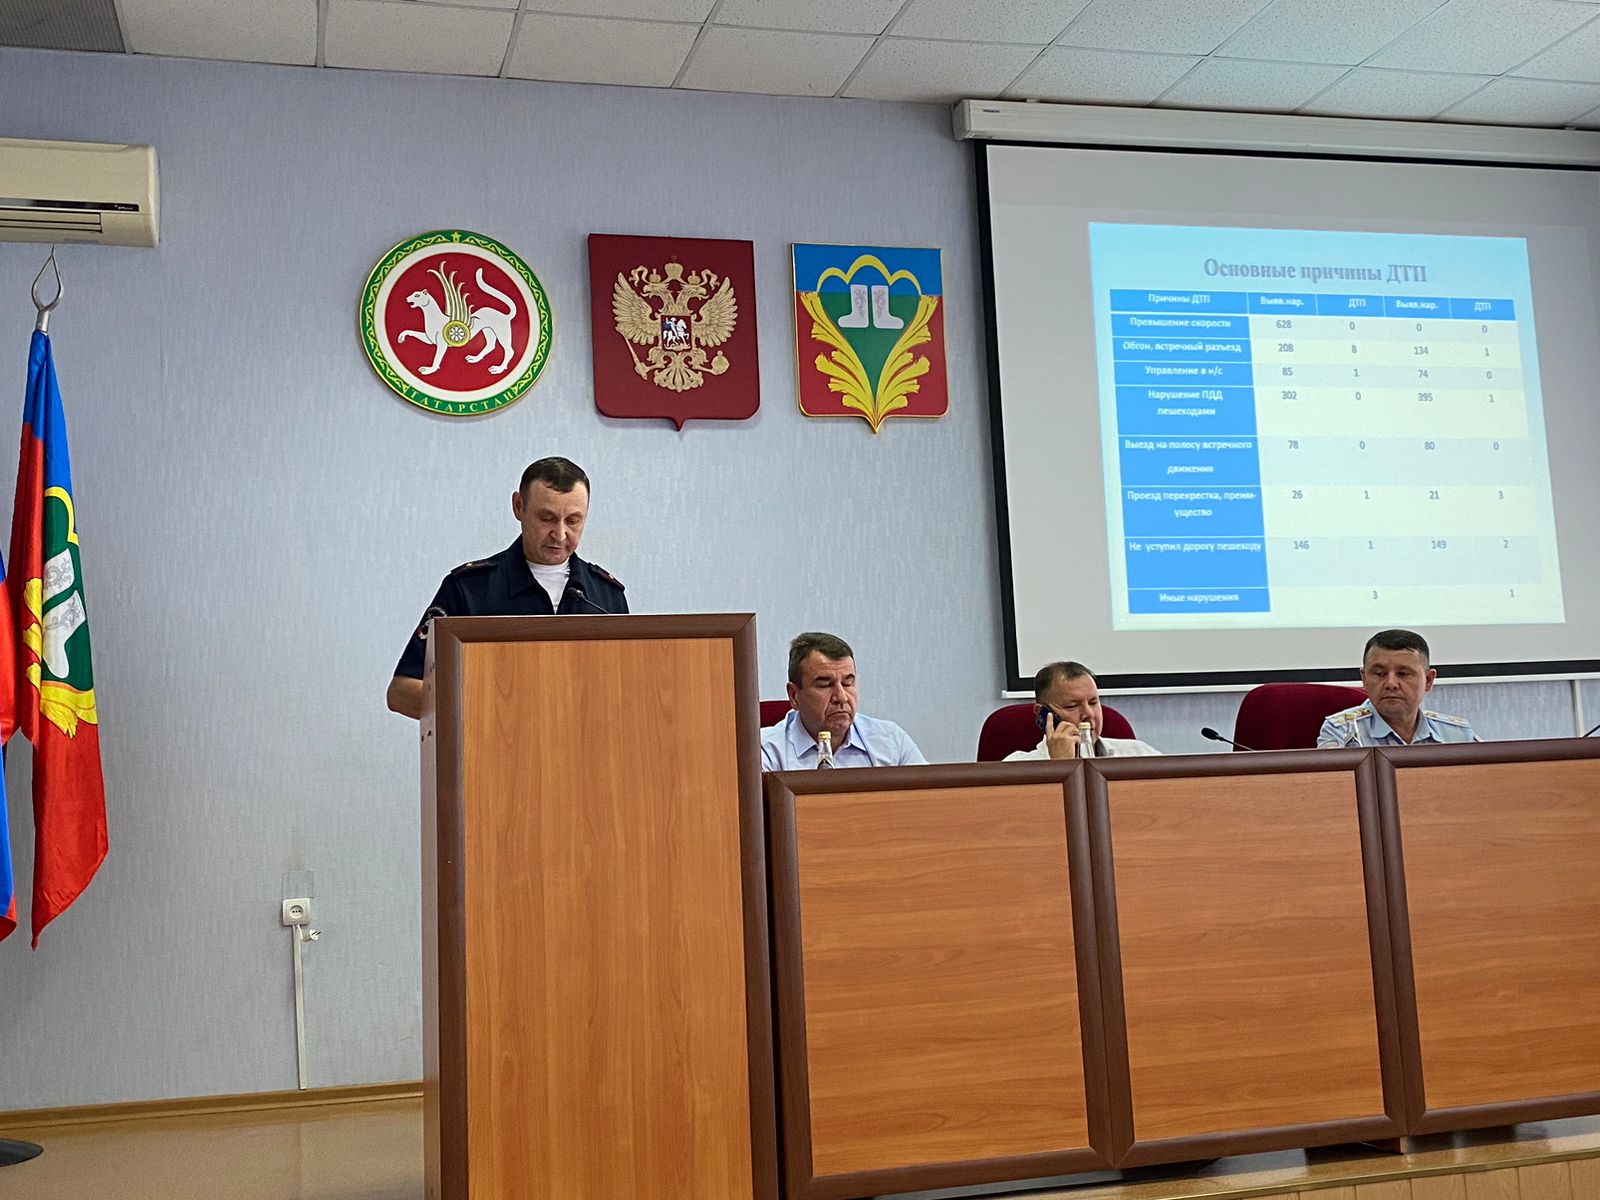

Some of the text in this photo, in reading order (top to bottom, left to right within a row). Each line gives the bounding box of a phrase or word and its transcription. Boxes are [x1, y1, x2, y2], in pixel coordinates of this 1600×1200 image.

[1204, 258, 1427, 284] Основные причины ДТП
[1148, 293, 1210, 304] Причины ДТП
[1260, 296, 1304, 306] Выяв.нар.
[1348, 299, 1366, 308] ДТП
[1396, 300, 1438, 310] Выяв.нар.
[1474, 302, 1491, 311] ДТП
[1130, 318, 1231, 328] Превышение скорости
[1276, 320, 1292, 329] 628
[1350, 322, 1355, 330] 0
[1417, 324, 1422, 332] 0
[1482, 325, 1488, 333] 0
[1155, 342, 1203, 352] встречный
[1205, 344, 1241, 353] разъезд
[1278, 344, 1293, 352] 208
[1352, 345, 1357, 354] 8
[1414, 346, 1429, 355] 134
[1145, 366, 1199, 375] Управление
[1208, 366, 1223, 375] н/с
[1282, 368, 1293, 376] 85
[1418, 370, 1428, 378] 74
[1487, 371, 1492, 379] 0
[1148, 391, 1223, 400] Нарушение ПДД
[1282, 391, 1297, 400] 302
[1356, 392, 1361, 400] 0
[1418, 393, 1433, 402] 395
[409, 390, 514, 413] ТАТАРСТАН
[1158, 408, 1216, 416] пешеходами
[1125, 440, 1154, 450] Выезд
[1169, 441, 1200, 450] полосу
[1203, 441, 1252, 450] встречного
[1288, 440, 1299, 449] 78
[1360, 441, 1365, 449] 0
[1493, 442, 1499, 450] 0
[1167, 465, 1214, 475] движения
[1128, 491, 1162, 500] Проезд
[1163, 492, 1222, 501] перекрестка,
[1292, 490, 1303, 499] 26
[1429, 491, 1439, 499] 21
[1498, 491, 1504, 499] 3
[1174, 509, 1212, 518] ущество
[1129, 542, 1261, 552] Не уступил дорогу пешеходу
[1293, 541, 1309, 549] 146
[1432, 541, 1447, 549] 149
[1503, 540, 1508, 548] 2
[1159, 594, 1239, 604] Иные нарушения
[1373, 591, 1378, 599] 3
